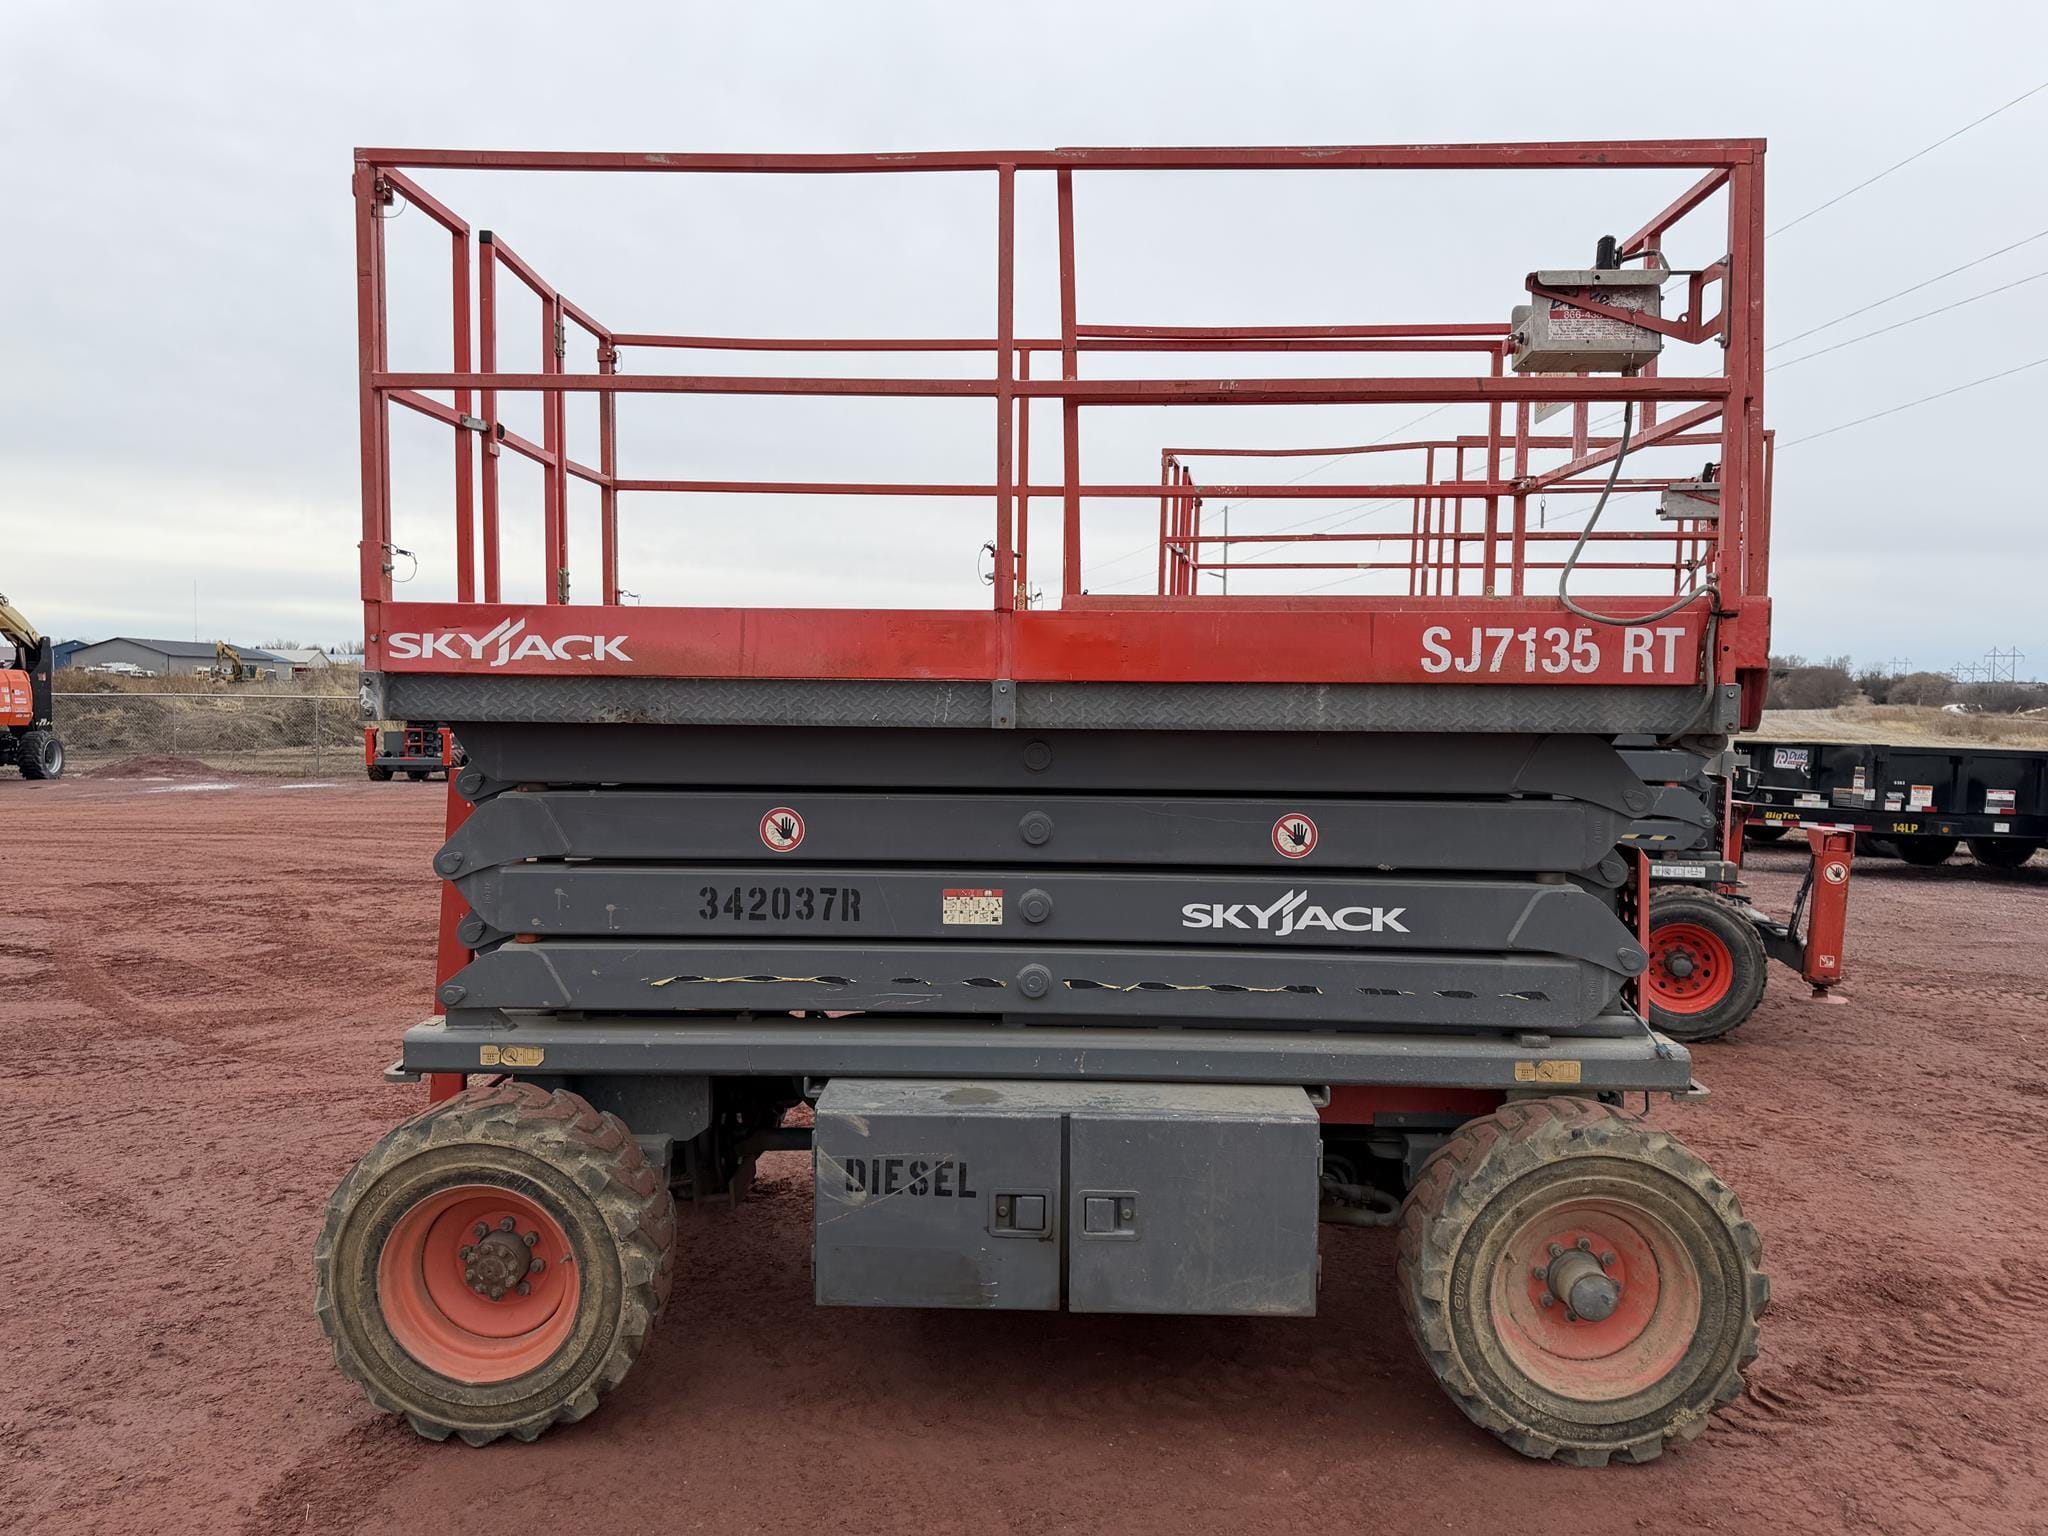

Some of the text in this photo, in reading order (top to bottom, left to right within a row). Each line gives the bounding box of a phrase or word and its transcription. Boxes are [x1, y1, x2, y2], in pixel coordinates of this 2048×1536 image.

[388, 617, 633, 667] SKYJACK
[1421, 626, 1686, 673] SJ7135 RT
[1892, 823, 1919, 833] 14LP
[699, 886, 861, 922] 342037R
[1182, 889, 1411, 937] SKYJACK
[845, 1158, 977, 1199] DIESEL
